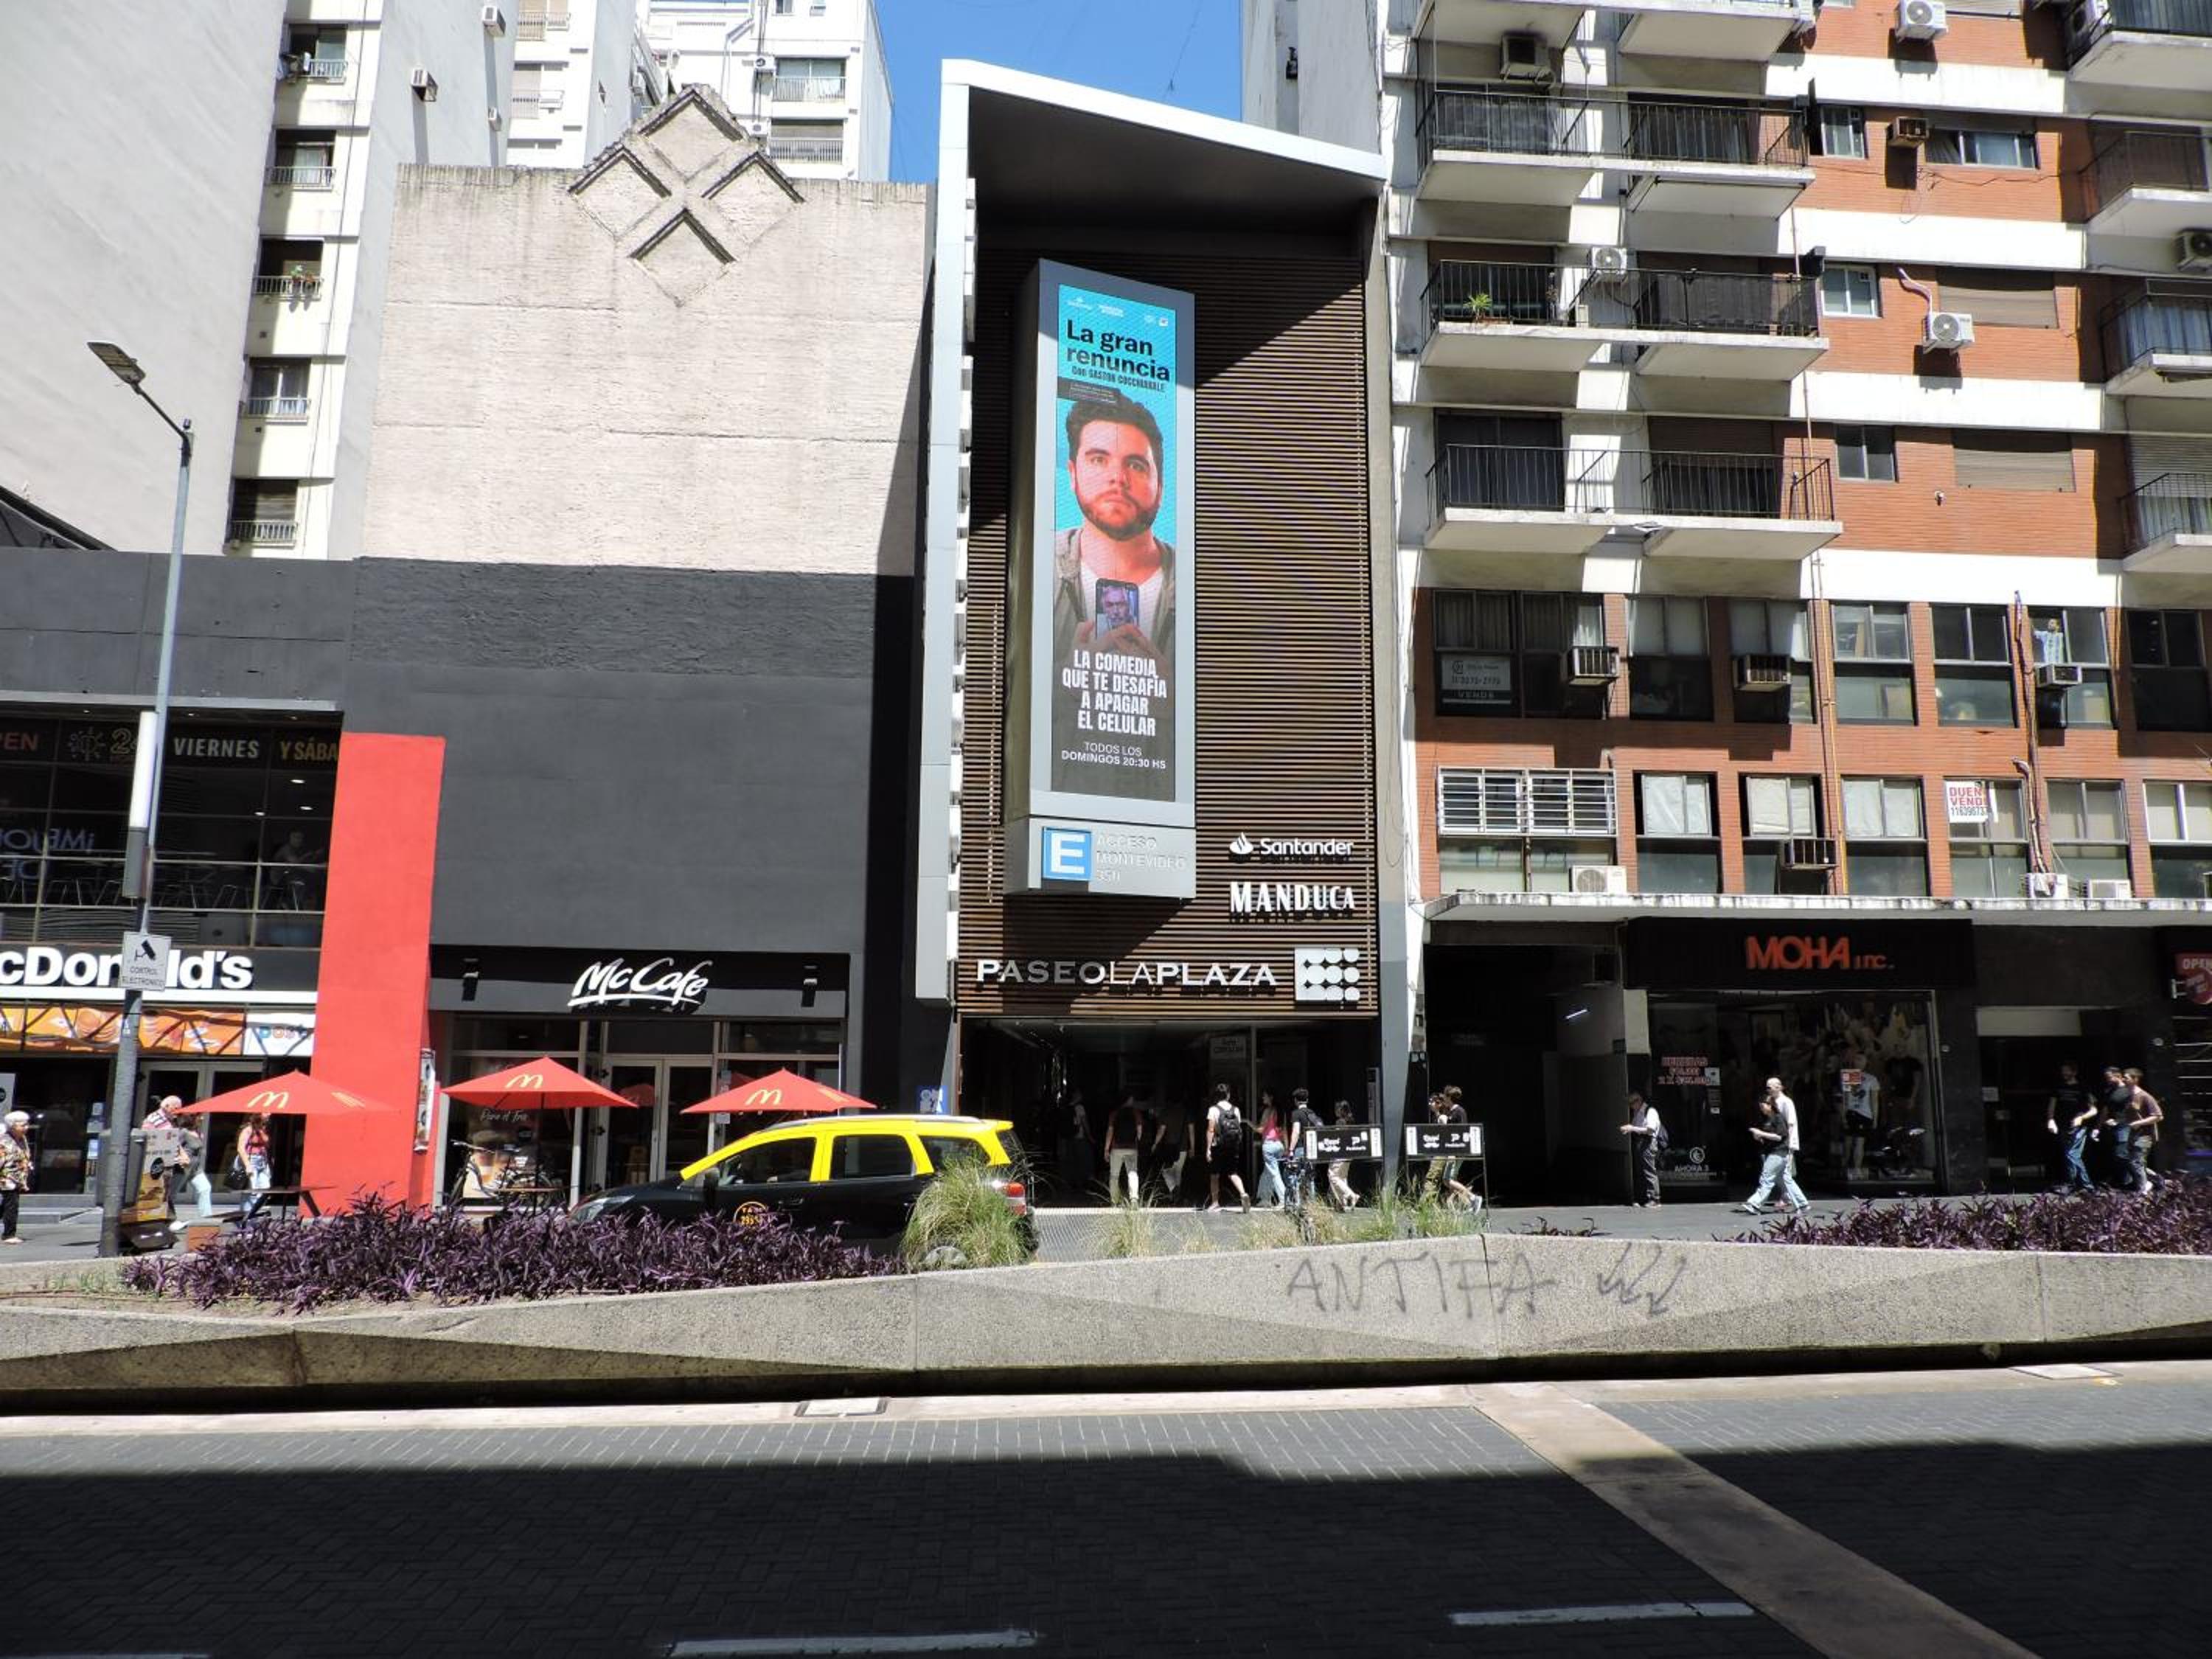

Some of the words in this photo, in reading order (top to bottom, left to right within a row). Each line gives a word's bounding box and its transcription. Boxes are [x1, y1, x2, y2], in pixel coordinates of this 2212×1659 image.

[1067, 319, 1093, 344] La
[1100, 331, 1152, 356] gran
[1066, 347, 1170, 382] renuncia
[1074, 650, 1090, 669] LA
[1095, 652, 1156, 676] COMEDIA
[1062, 668, 1089, 690] QUE
[1093, 672, 1108, 692] TE
[1113, 675, 1167, 699] DESAFÍA
[1081, 690, 1090, 709] A
[1095, 692, 1149, 716] APAGAR
[1078, 710, 1093, 730] EL
[1098, 712, 1156, 737] CELULAR
[173, 737, 259, 759] VIERNES
[279, 740, 291, 761] Y
[1061, 750, 1120, 765] DOMINGOS
[1123, 756, 1150, 768] 20:30
[1152, 759, 1166, 770] HS
[1084, 741, 1120, 754] TODOS
[1122, 745, 1142, 757] LOS
[1949, 786, 1983, 797] DUEN
[1950, 797, 1984, 806] VEND
[1051, 832, 1085, 874] E
[1096, 833, 1158, 851] ACCESO
[1260, 838, 1354, 855] Santander
[1096, 849, 1187, 869] MONTEVIDEO
[1230, 881, 1356, 913] MANDUCA
[1745, 935, 1851, 970] MOHA
[0, 946, 254, 989] cDonld's
[1287, 1251, 1557, 1319] ANTIFA
